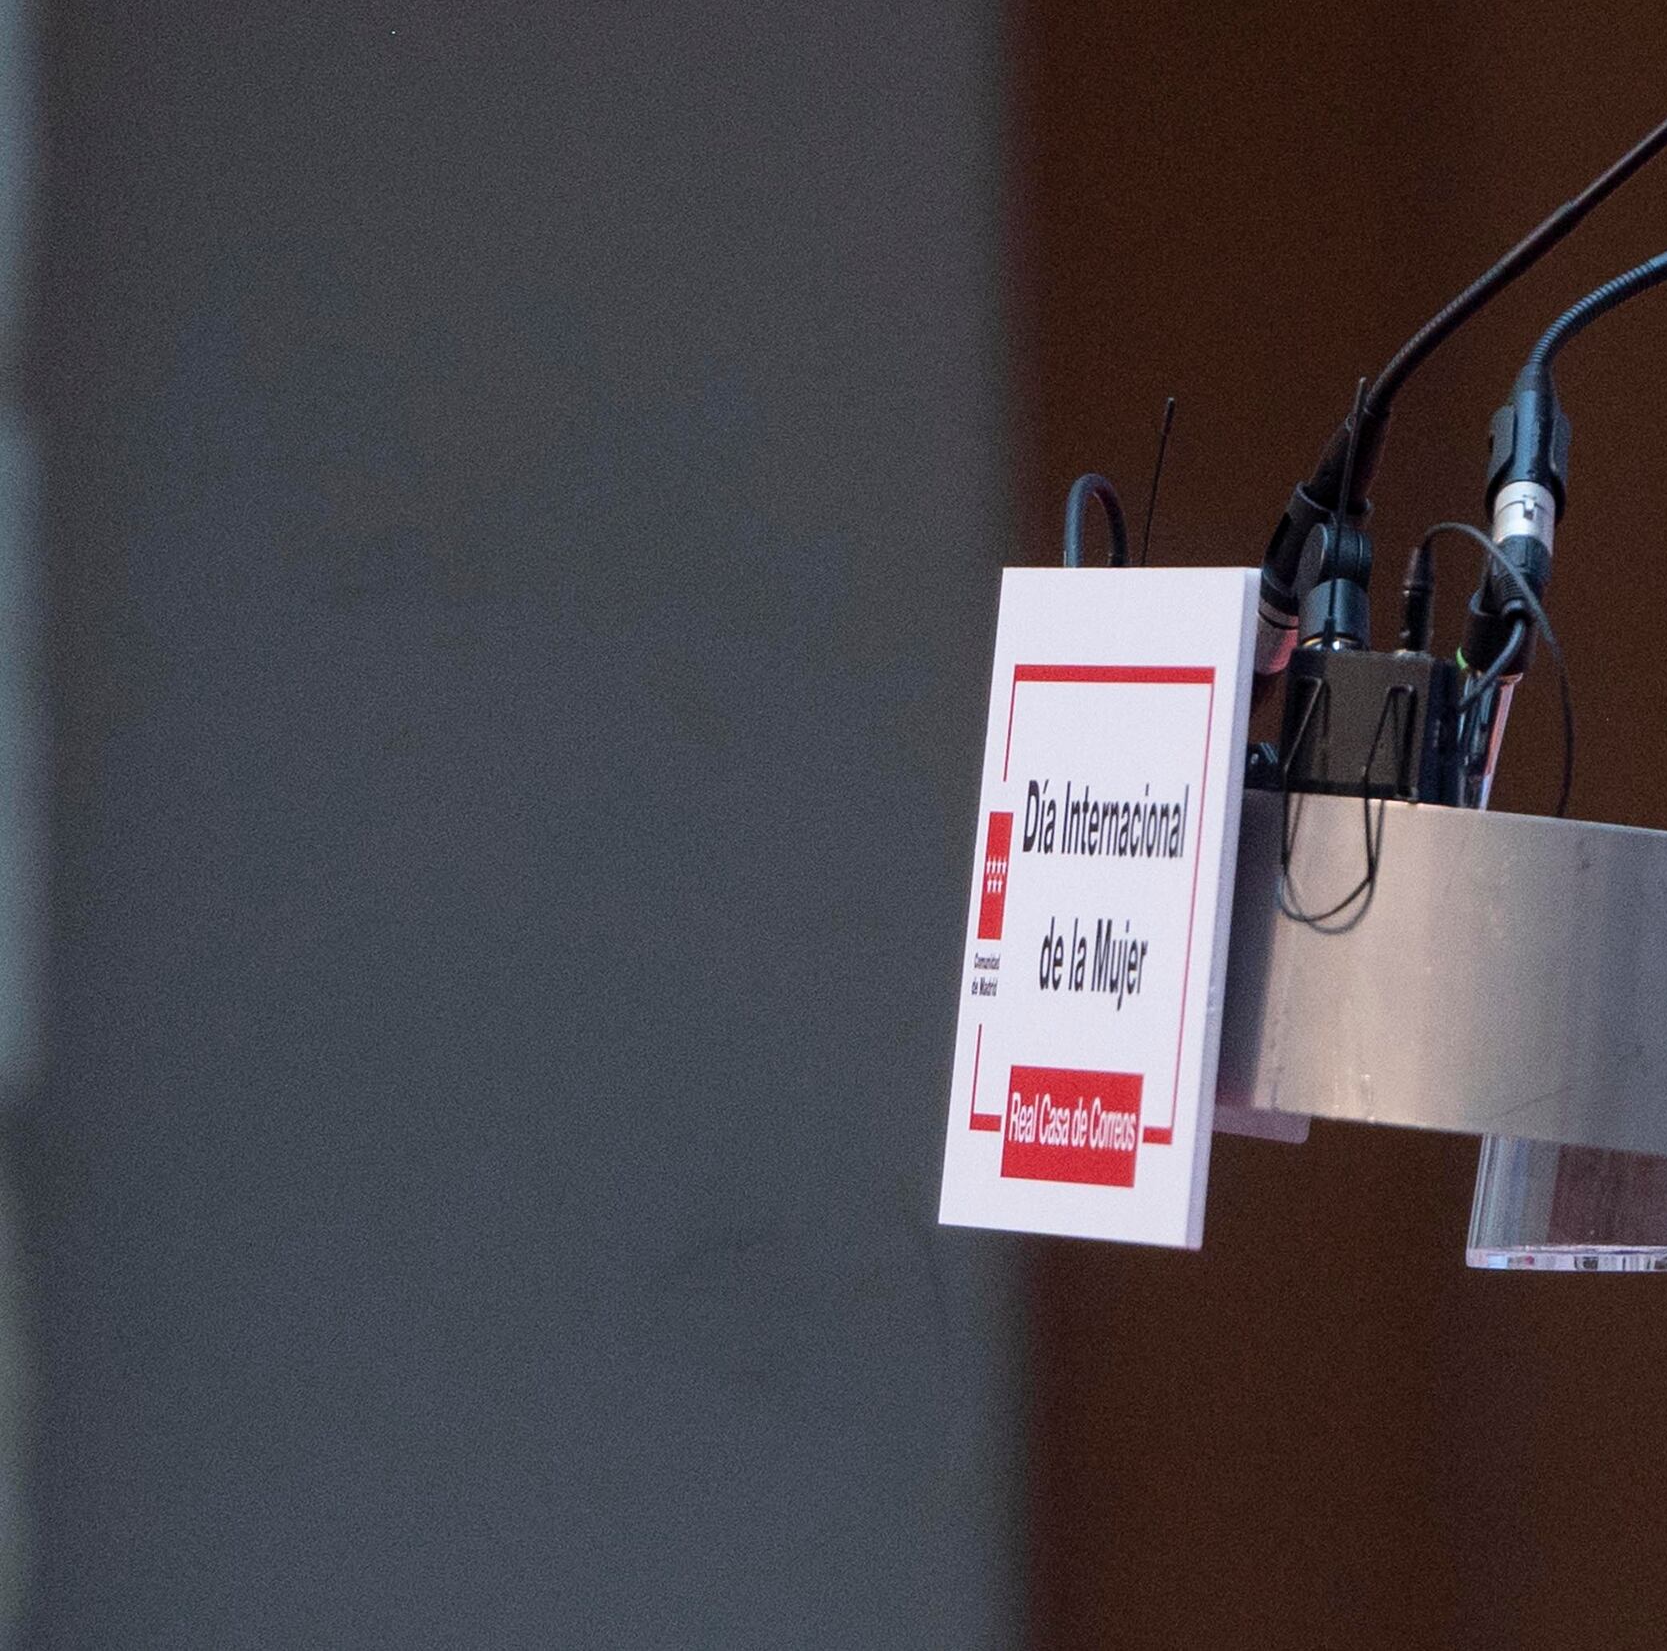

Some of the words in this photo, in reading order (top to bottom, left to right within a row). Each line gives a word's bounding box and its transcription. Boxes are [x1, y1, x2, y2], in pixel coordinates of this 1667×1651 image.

[1022, 779, 1057, 855] Día
[1061, 780, 1189, 859] Internacional
[1040, 916, 1064, 991] de
[1068, 917, 1087, 992] la
[1091, 918, 1148, 1011] Mujer
[1008, 1091, 1039, 1143] Real
[1039, 1093, 1071, 1147] Casa
[1071, 1096, 1088, 1147] de
[1089, 1097, 1137, 1152] Correos
